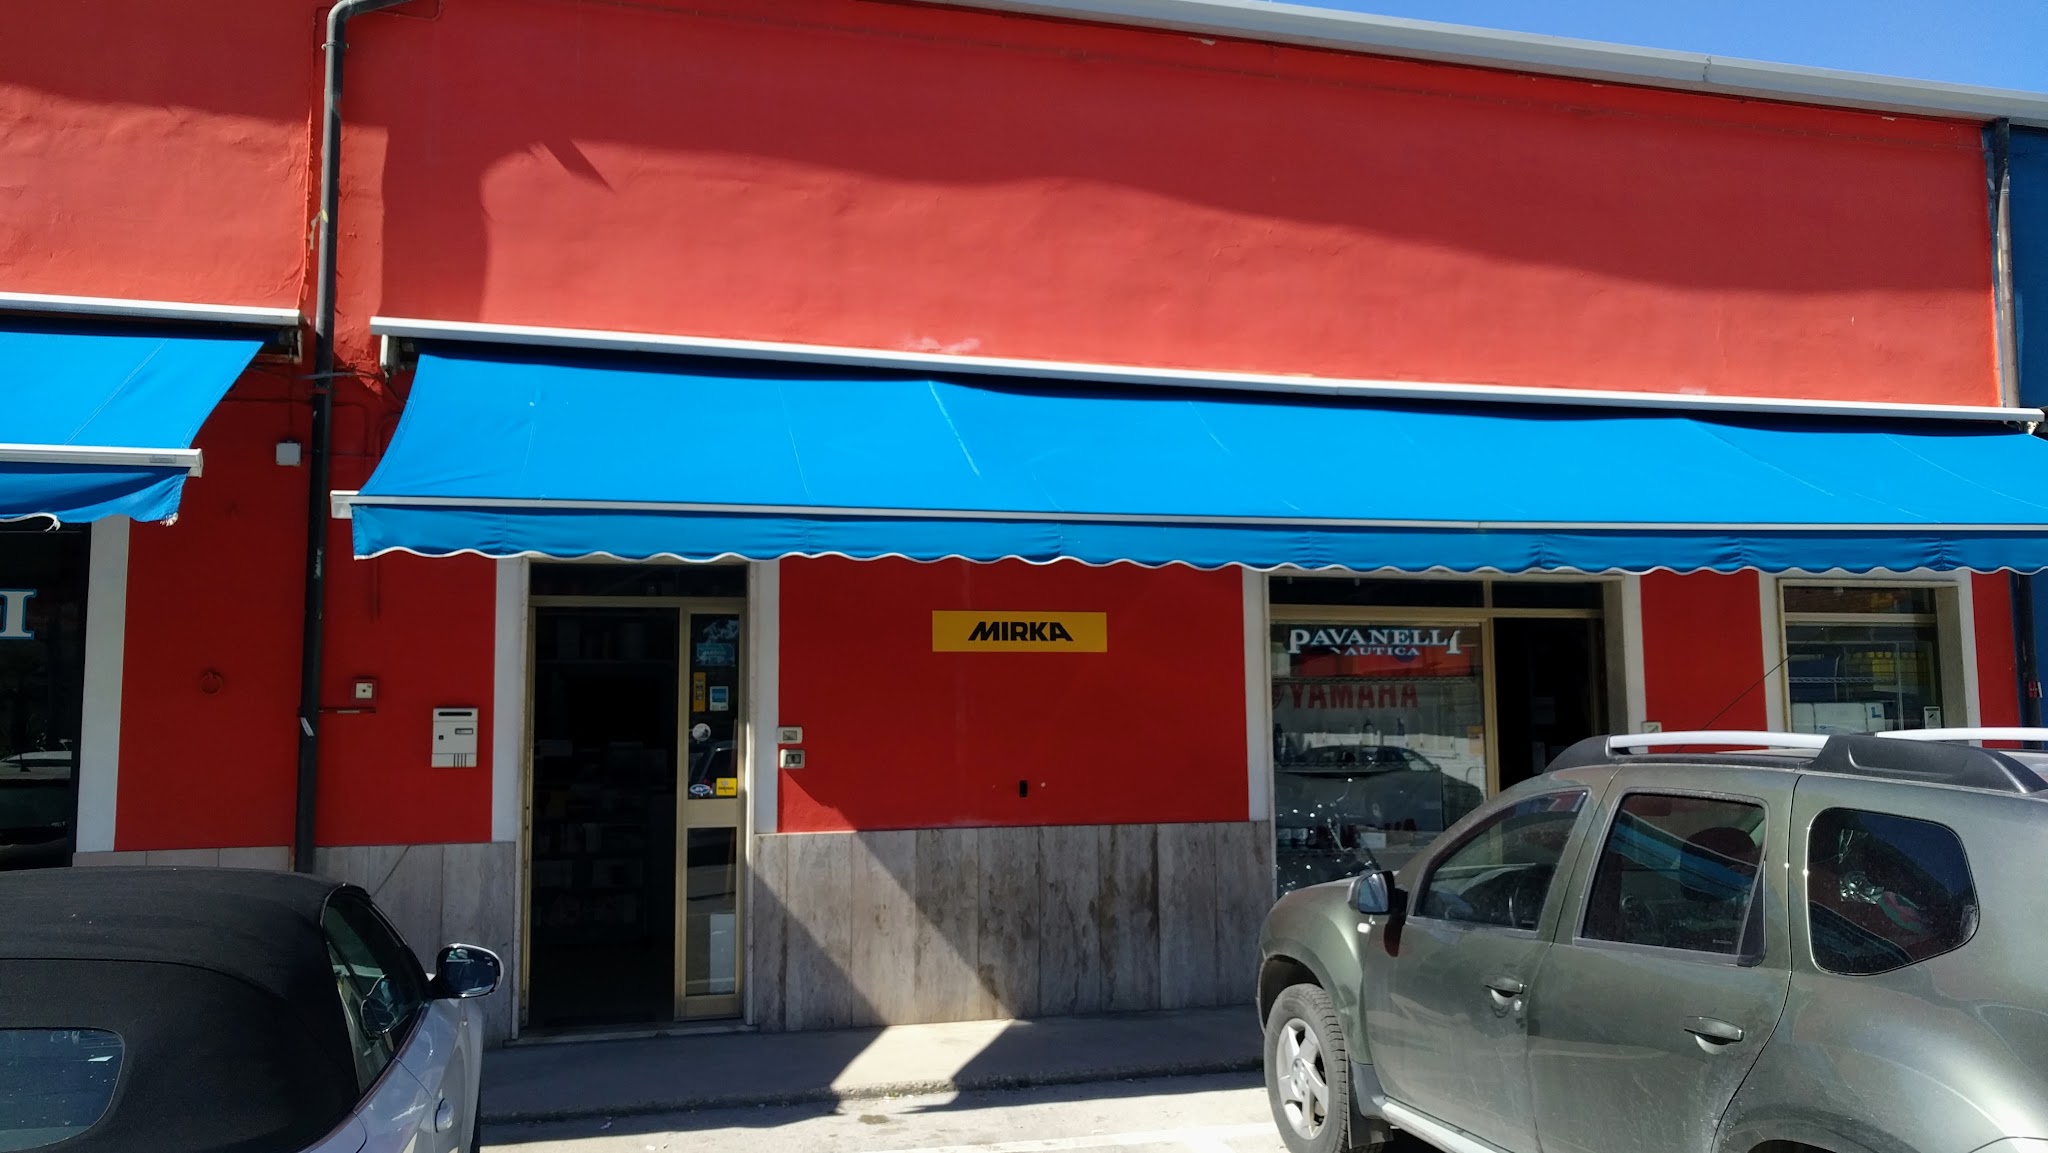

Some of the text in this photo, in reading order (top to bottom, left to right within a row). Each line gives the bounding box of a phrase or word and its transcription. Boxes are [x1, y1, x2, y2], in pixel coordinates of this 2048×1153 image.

[968, 621, 1074, 641] MIRKA
[1287, 628, 1461, 653] PAVANELLI
[1290, 683, 1418, 709] YAMAHA
